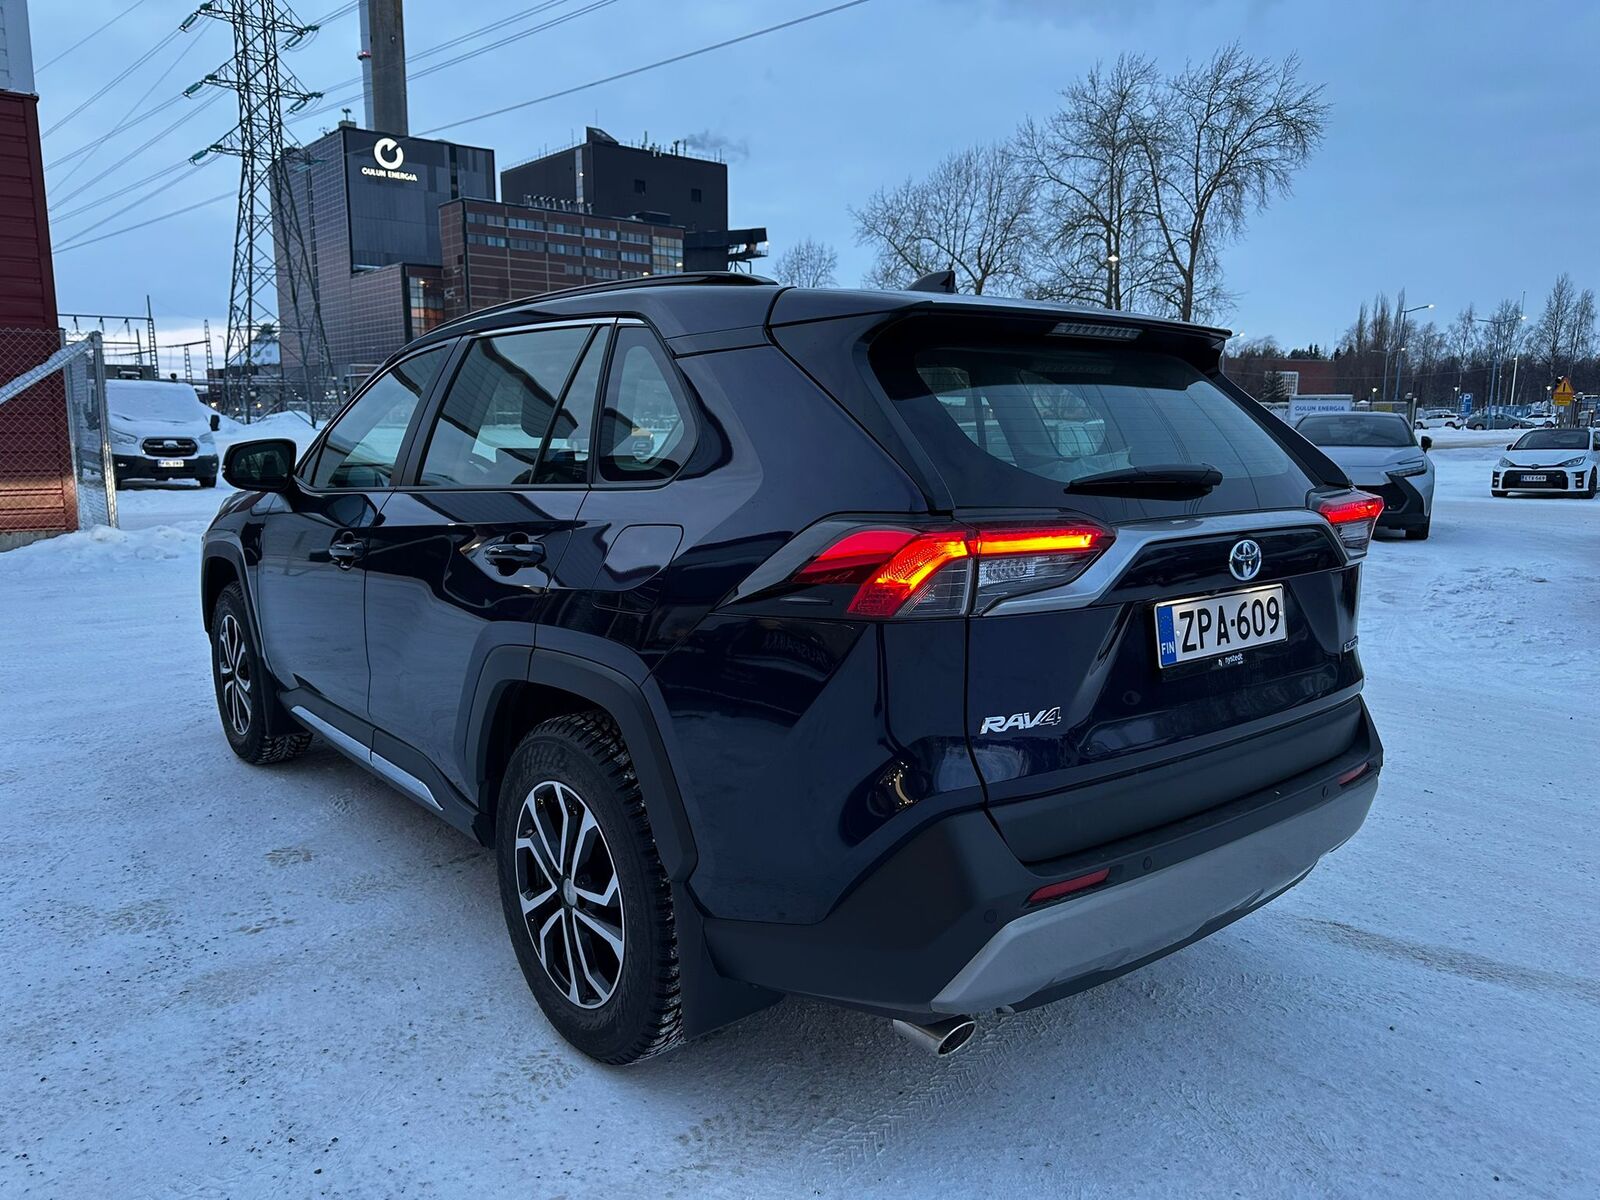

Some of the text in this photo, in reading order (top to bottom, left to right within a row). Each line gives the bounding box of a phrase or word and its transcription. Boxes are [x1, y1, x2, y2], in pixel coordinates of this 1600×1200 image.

[361, 167, 418, 181] OULUN ENERGIA
[1161, 641, 1175, 656] FIN
[980, 706, 1062, 735] RAV4
